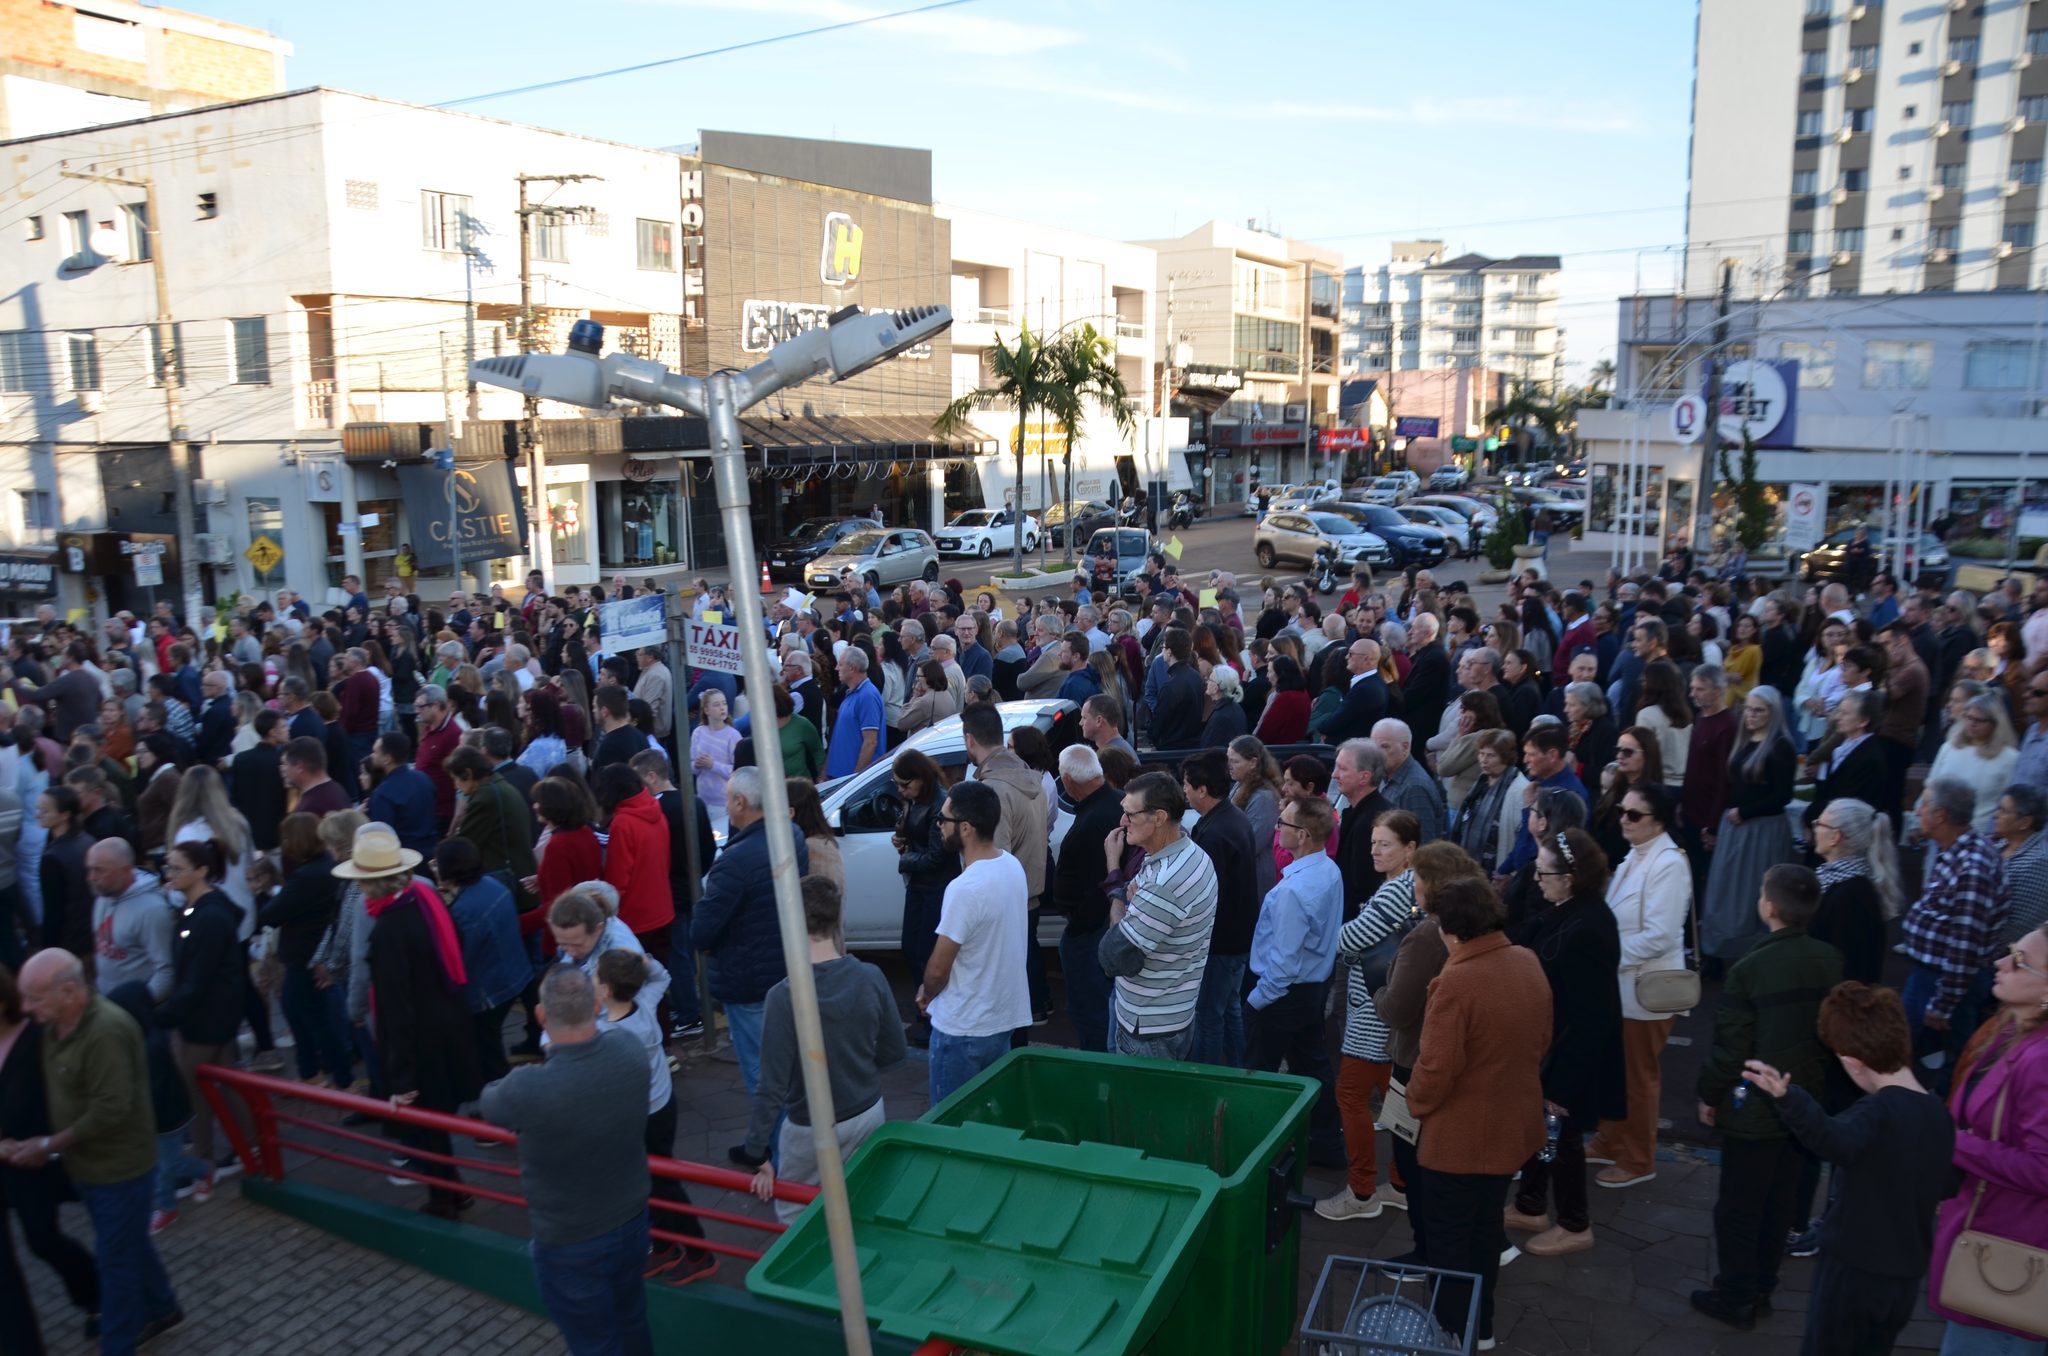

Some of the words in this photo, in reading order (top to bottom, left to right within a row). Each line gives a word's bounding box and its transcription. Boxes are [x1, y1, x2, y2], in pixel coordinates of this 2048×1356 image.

[680, 170, 705, 333] HOTEL
[691, 625, 740, 651] TÁXI
[689, 645, 699, 654] 55
[700, 647, 743, 661] 99958-438
[697, 656, 738, 671] 3744-1792
